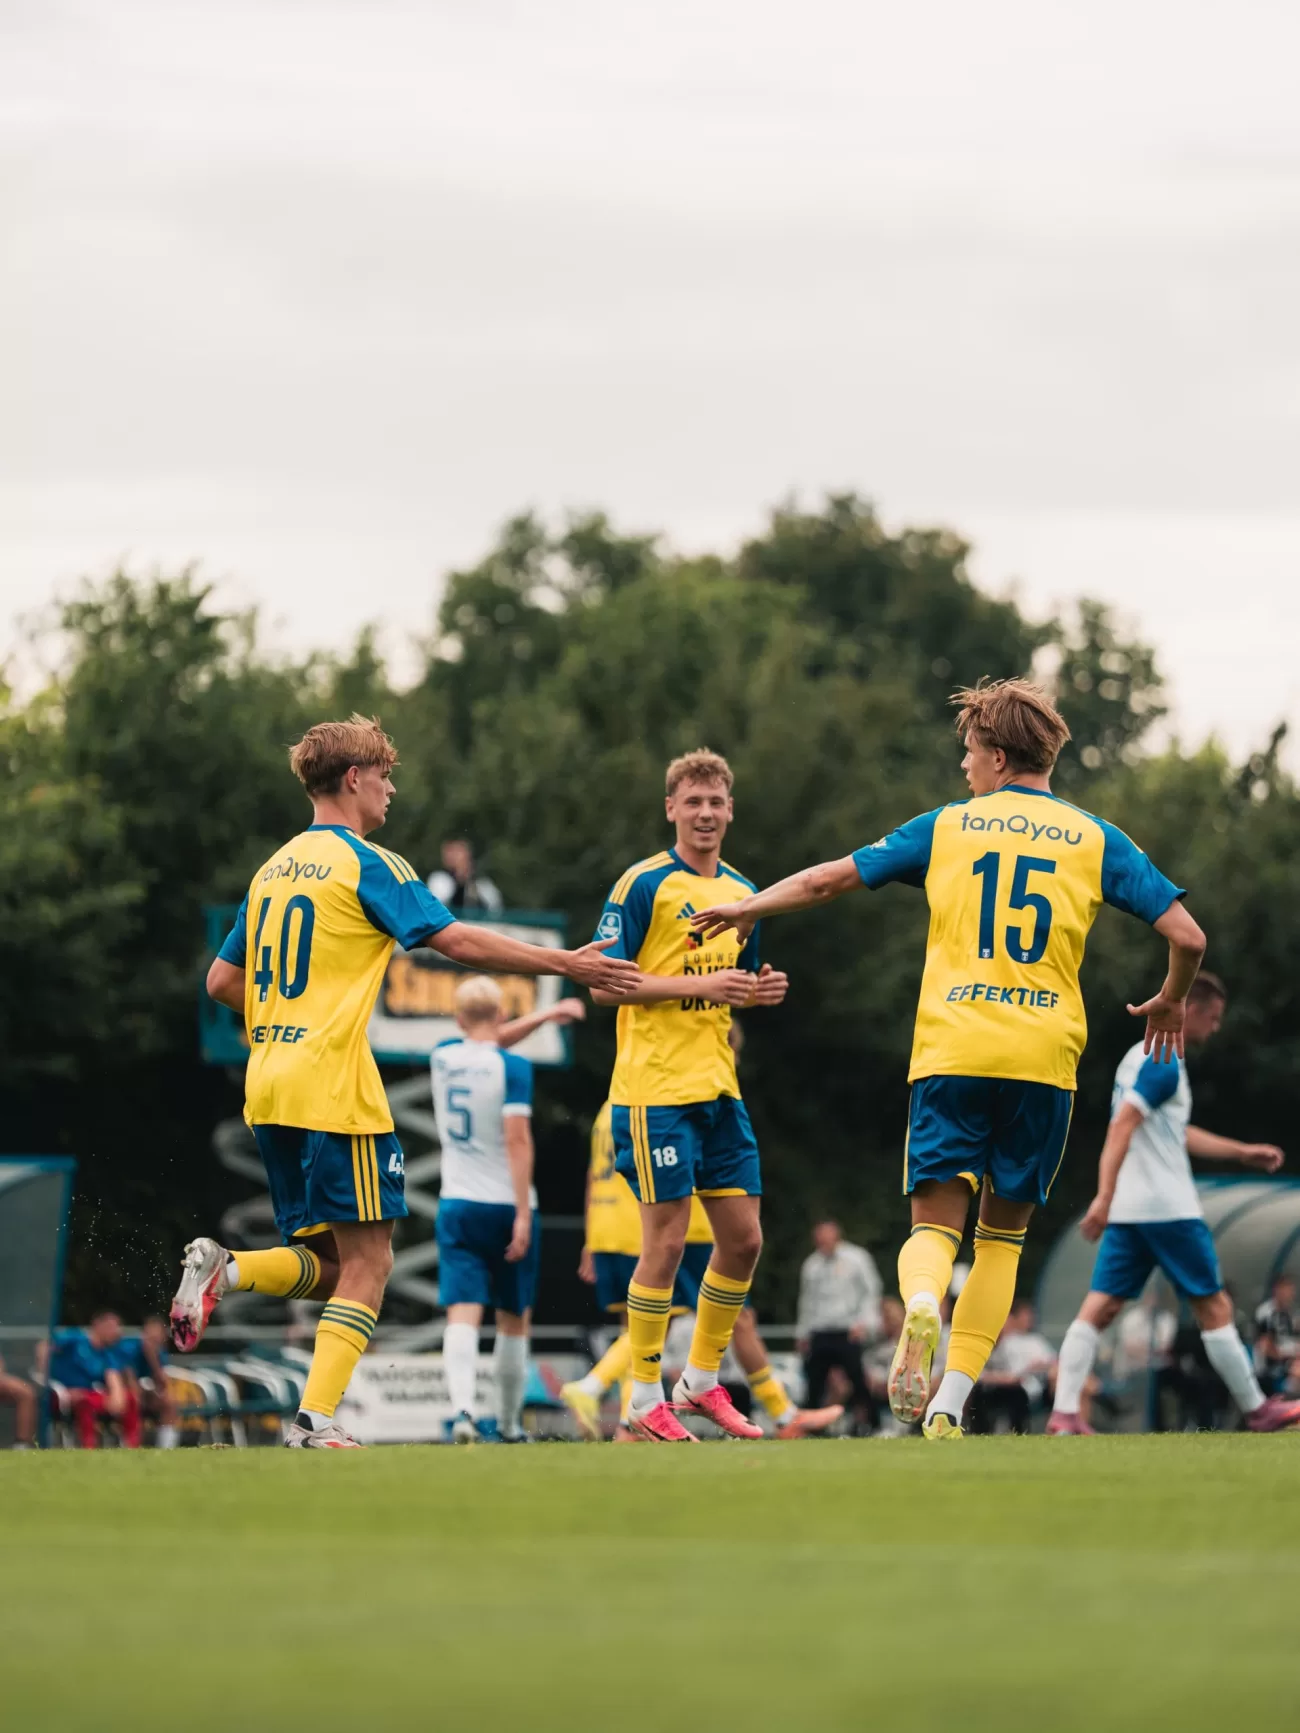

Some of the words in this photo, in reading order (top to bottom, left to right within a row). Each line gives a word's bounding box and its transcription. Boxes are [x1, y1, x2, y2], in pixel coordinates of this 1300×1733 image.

[961, 812, 1082, 845] tanQyou
[260, 857, 332, 882] anQyou
[972, 851, 1057, 965] 15
[254, 894, 315, 1002] 40
[684, 952, 734, 965] BOUWG
[946, 983, 1059, 1008] EFFEKTIEF
[447, 1087, 472, 1141] 5
[652, 1145, 678, 1168] 18
